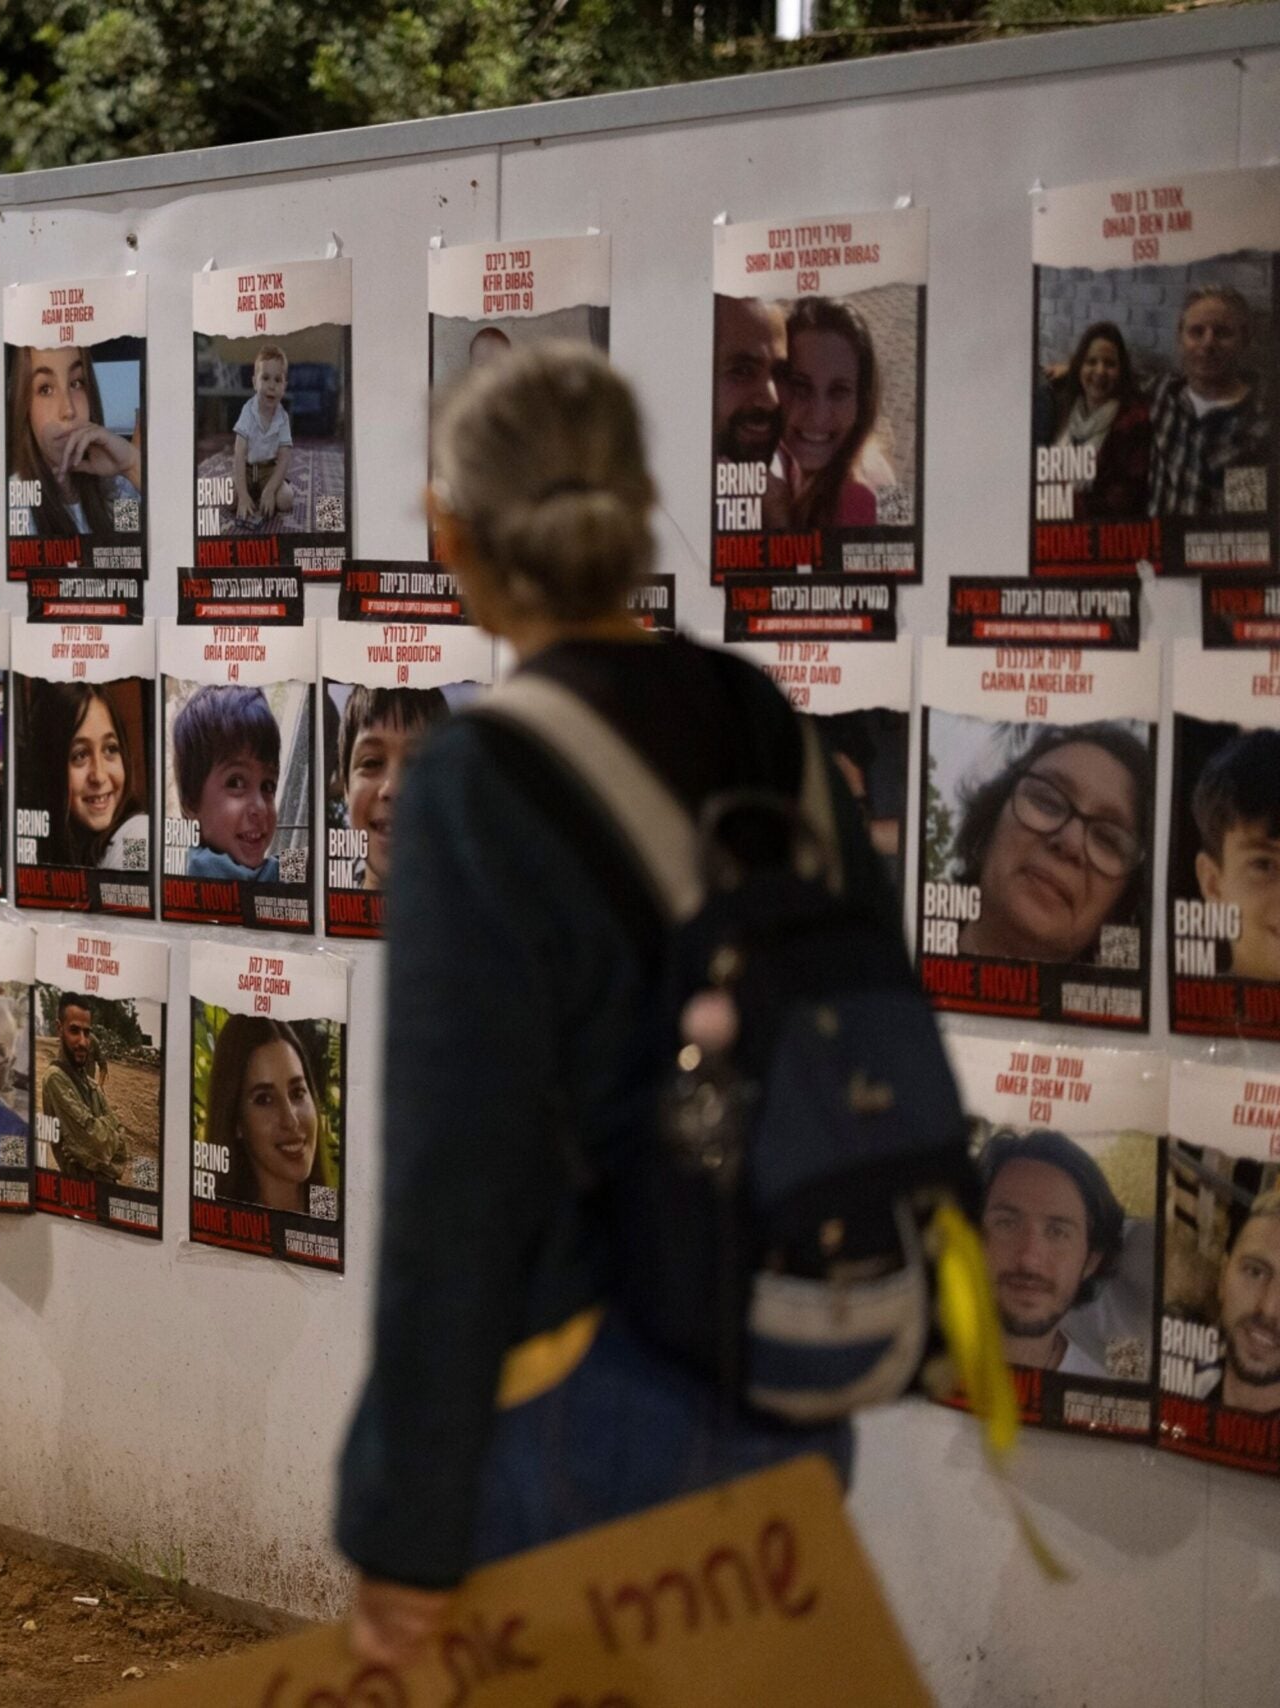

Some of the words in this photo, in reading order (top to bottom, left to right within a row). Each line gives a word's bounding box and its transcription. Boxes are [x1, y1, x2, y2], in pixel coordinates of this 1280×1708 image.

[824, 223, 852, 243] שירי
[1102, 216, 1135, 238] OHAD
[1139, 213, 1163, 234] BEN
[1167, 210, 1192, 232] AMI
[485, 253, 506, 271] ביבס
[509, 251, 531, 270] כפיר
[745, 254, 770, 273] SHIRI
[773, 251, 795, 270] AND
[798, 247, 842, 269] YARDEN
[844, 244, 880, 265] BIBAS
[238, 275, 255, 293] ביבס
[257, 273, 283, 290] אריאל
[483, 274, 503, 292] KFIR
[505, 271, 534, 291] BIBAS
[796, 271, 820, 293] (32)
[42, 309, 62, 325] AGAM
[65, 306, 94, 323] BERGER
[237, 294, 257, 312] ARIEL
[260, 292, 285, 310] BIBAS
[59, 326, 74, 343] (19)
[254, 313, 266, 331] (4)
[1036, 446, 1096, 481] BRING
[197, 477, 234, 506] BRING
[716, 462, 767, 495] BRING
[9, 480, 42, 507] BRING
[1036, 484, 1073, 520] HIM
[9, 508, 30, 536] HER
[197, 508, 220, 536] HIM
[716, 498, 762, 530] THEM
[9, 539, 41, 566] HOME
[198, 541, 233, 567] HOME
[236, 536, 280, 567] NOW!
[715, 536, 765, 568] HOME
[410, 626, 427, 643] יובל
[52, 644, 69, 659] OFRY
[71, 643, 110, 659] BRODUTCH
[204, 645, 222, 660] ORIA
[225, 645, 266, 661] BRODUTCH
[367, 647, 393, 662] YUVAL
[396, 645, 441, 663] BRODUTCH
[228, 663, 239, 681] (4)
[397, 665, 409, 683] (8)
[810, 665, 841, 685] DAVID
[981, 672, 1025, 691] CARINA
[788, 687, 810, 707] (23)
[1025, 696, 1048, 717] (51)
[17, 808, 50, 837] BRING
[165, 818, 200, 847] BRING
[17, 837, 38, 865] HER
[329, 828, 368, 858] BRING
[164, 847, 186, 875] HIM
[328, 860, 353, 889] HIM
[164, 880, 198, 908] HOME
[201, 881, 240, 912] NOW!
[329, 893, 368, 923] HOME
[924, 882, 981, 921] BRING
[1174, 900, 1240, 940] BRING
[923, 918, 959, 956] HER
[66, 954, 94, 972] NIMROD
[95, 958, 120, 976] COHEN
[249, 956, 262, 974] כהן
[265, 958, 284, 976] ספיר
[1175, 938, 1215, 977] HIM
[84, 974, 99, 992] (19)
[238, 974, 262, 992] SAPIR
[264, 977, 291, 996] COHEN
[923, 959, 974, 998] HOME
[254, 994, 271, 1014] (29)
[995, 1073, 1027, 1096] OMER
[1031, 1077, 1064, 1100] SHEM
[1068, 1082, 1092, 1104] TOV
[1029, 1099, 1052, 1124] (21)
[36, 1113, 60, 1143] RING
[193, 1140, 230, 1174] BRING
[193, 1169, 216, 1200] HER
[194, 1201, 227, 1234] HOME
[231, 1210, 270, 1242] NOW!
[1161, 1316, 1219, 1362] BRING
[1160, 1353, 1195, 1398] HIM
